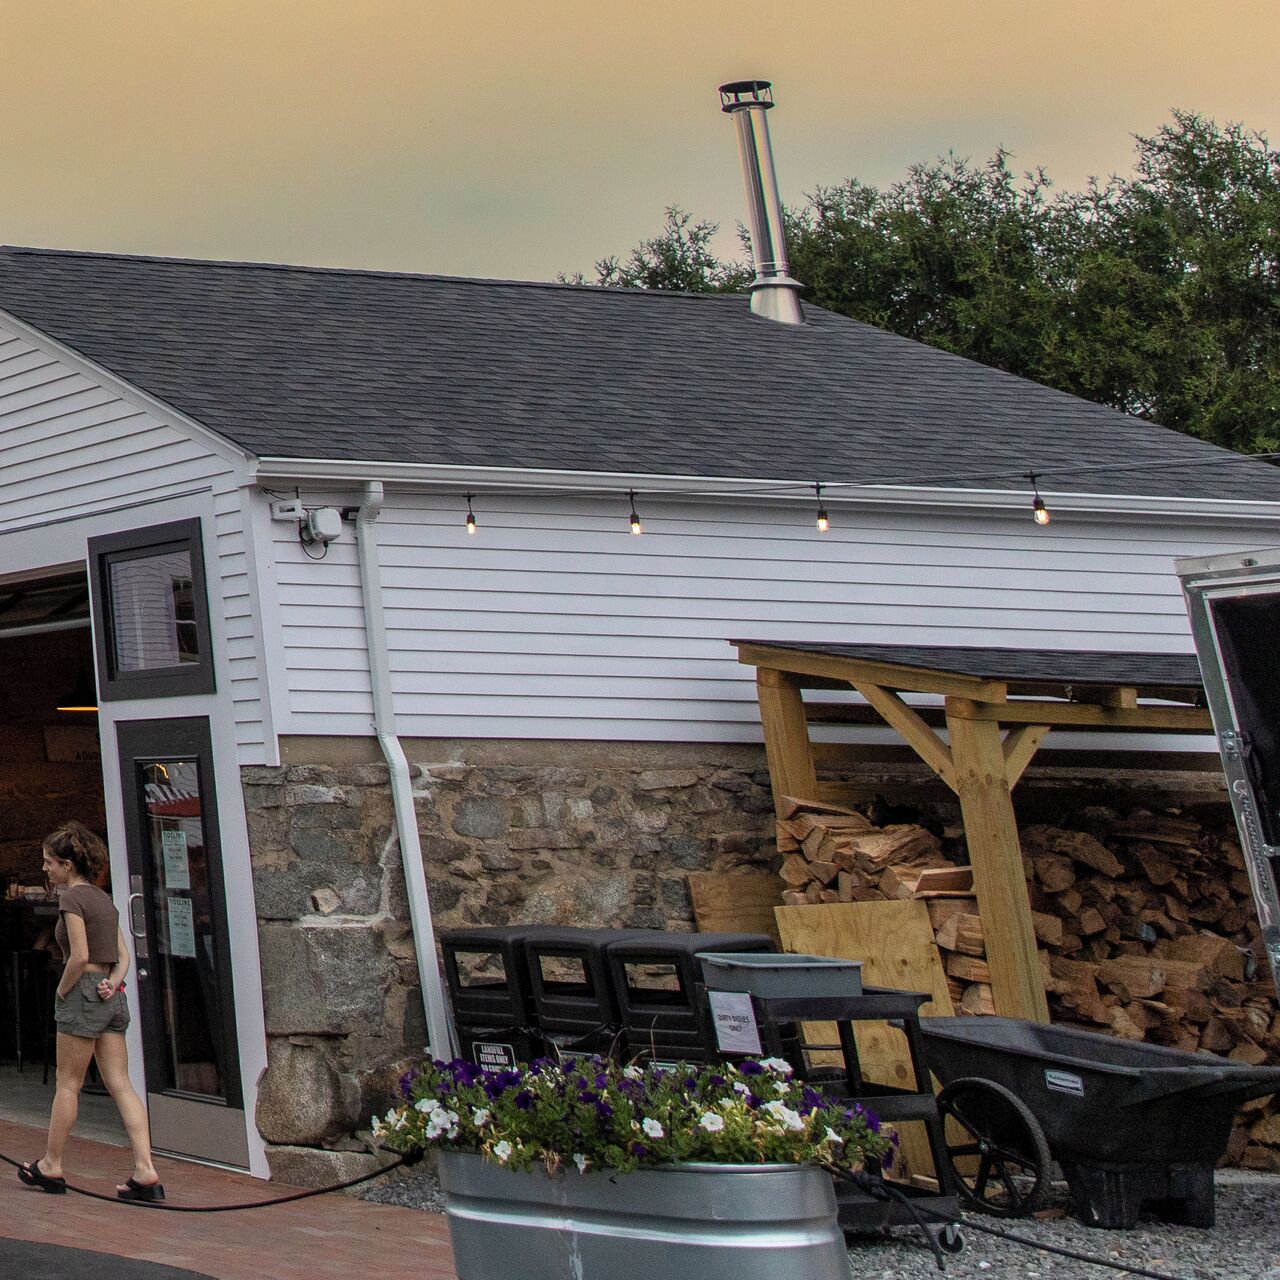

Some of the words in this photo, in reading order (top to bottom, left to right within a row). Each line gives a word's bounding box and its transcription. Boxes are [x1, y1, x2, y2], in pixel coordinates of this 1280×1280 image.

[481, 1045, 505, 1055] LANDFILL
[480, 1053, 496, 1063] ITEMS
[495, 1055, 509, 1064] ONLY
